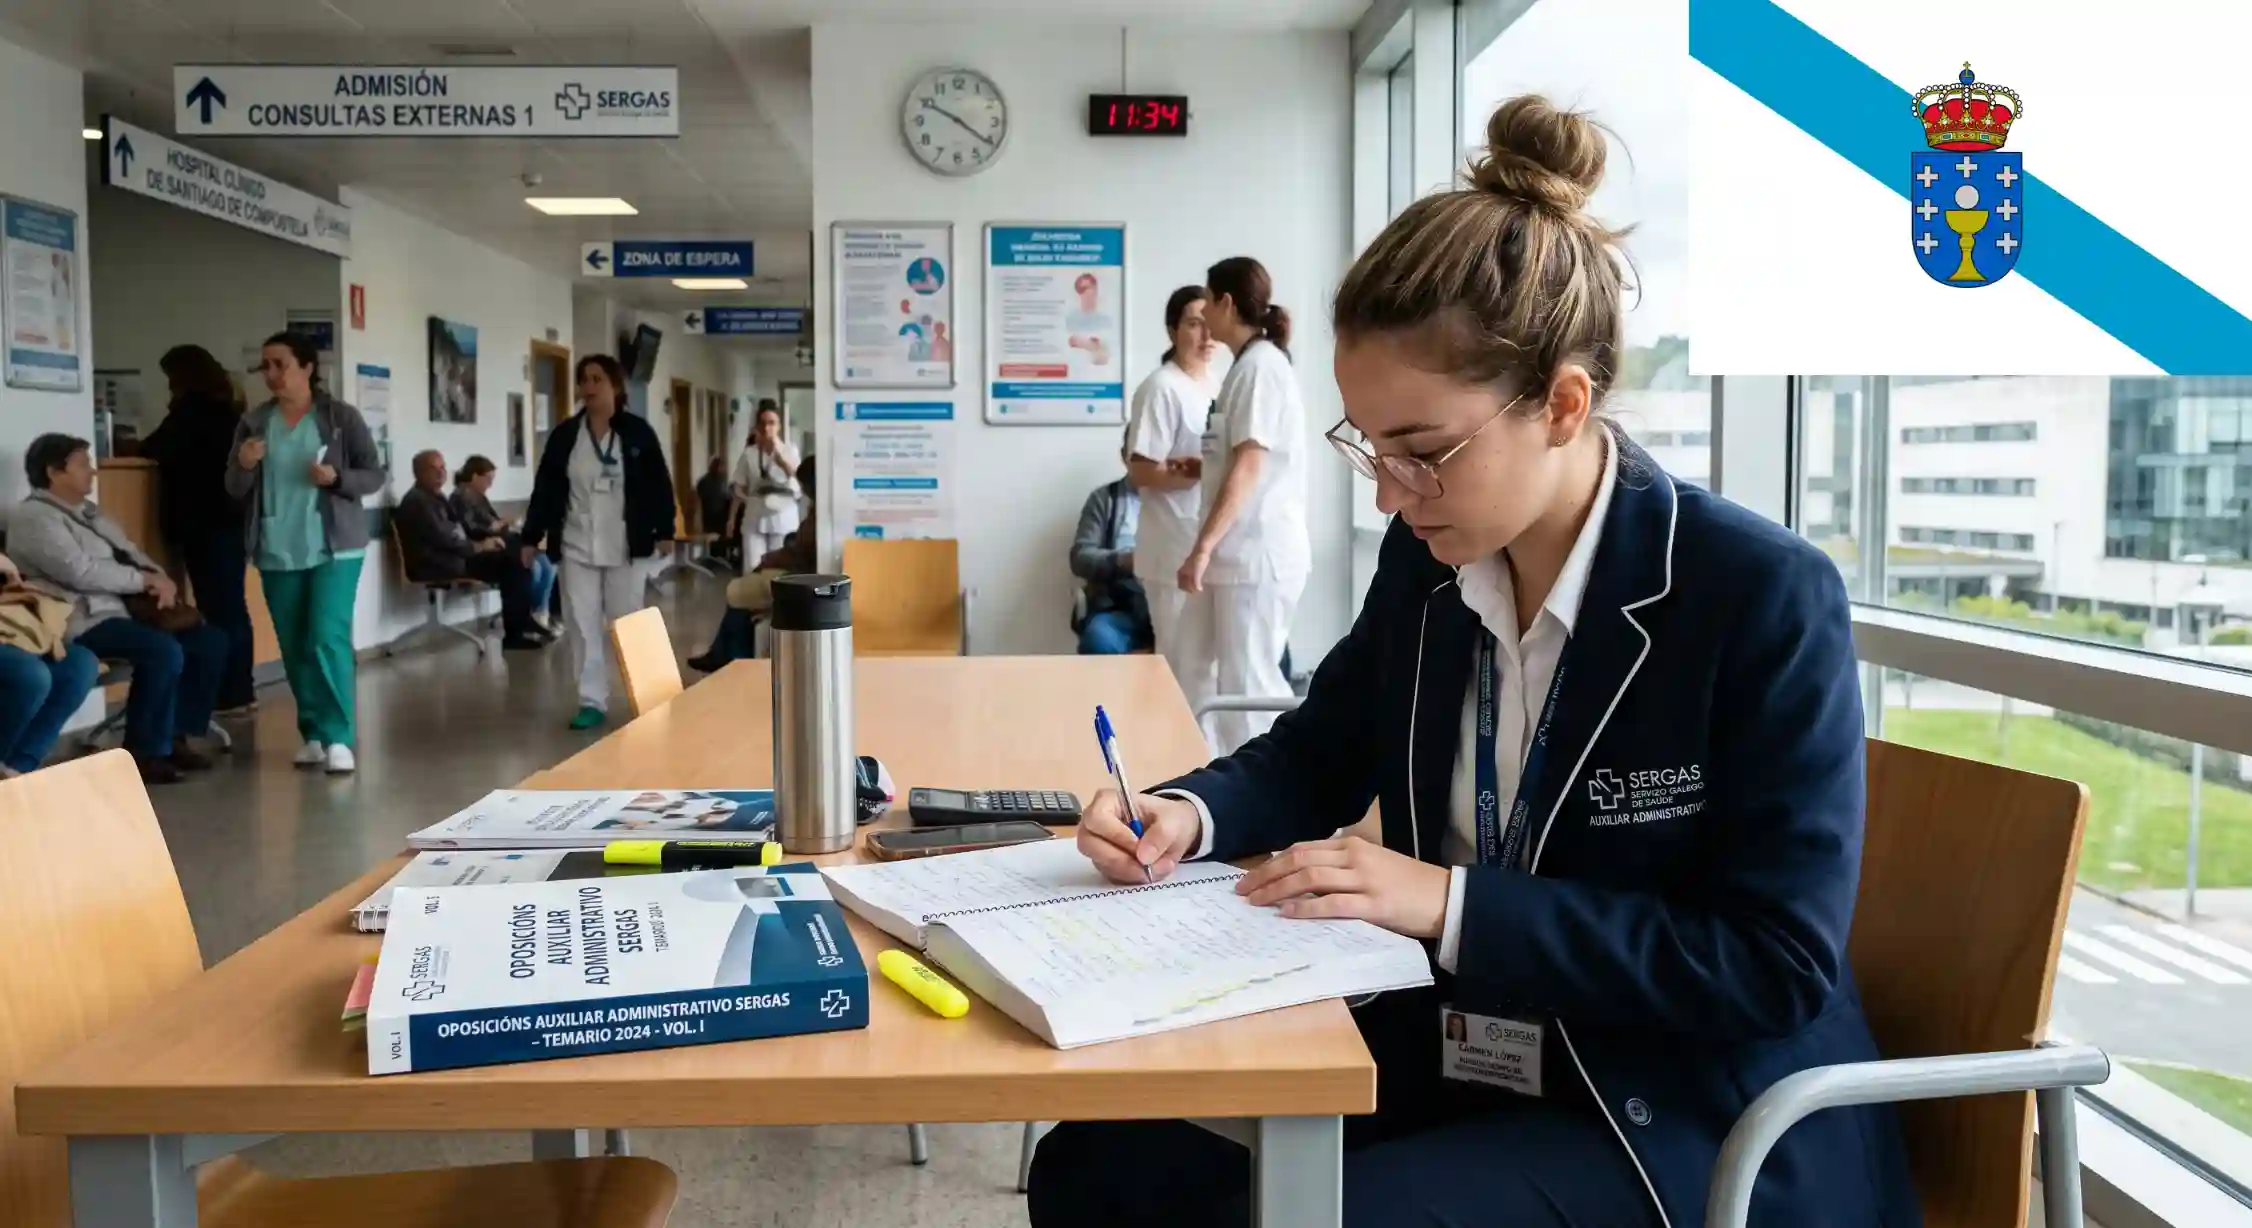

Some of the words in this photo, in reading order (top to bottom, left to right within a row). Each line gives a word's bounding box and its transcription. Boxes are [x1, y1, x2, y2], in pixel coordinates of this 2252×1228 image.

[333, 68, 448, 97] ADMISIÓN
[596, 90, 671, 109] SERGAS
[247, 103, 387, 127] CONSULTAS
[393, 103, 517, 127] EXTERNAS
[523, 104, 533, 127] 1
[1108, 101, 1180, 130] 11:34
[621, 251, 662, 267] ZONA
[664, 251, 684, 267] DE
[685, 250, 741, 267] ESPERA
[1628, 763, 1701, 789] SERGAS
[1630, 787, 1668, 799] SERVIZO
[1668, 781, 1705, 796] GALEGO
[1631, 799, 1644, 809] DE
[1589, 811, 1631, 827] AUXILIAR
[508, 903, 537, 980] OPOSICIÓNS
[547, 908, 573, 966] AUXILIAR
[578, 886, 611, 986] ADMINISTRATIVO
[614, 908, 644, 954] SERGAS
[410, 945, 432, 980] SERGAS
[437, 1015, 532, 1038] OPOSICIÓNS
[534, 1009, 604, 1030] AUXILIAR
[606, 997, 733, 1024] ADMINISTRATIVO
[735, 992, 791, 1012] SERGAS
[542, 1026, 612, 1048] TEMARIO
[614, 1024, 652, 1042] 2024
[662, 1019, 697, 1036] VOL.
[699, 1019, 705, 1033] I
[391, 1037, 403, 1061] VOL.
